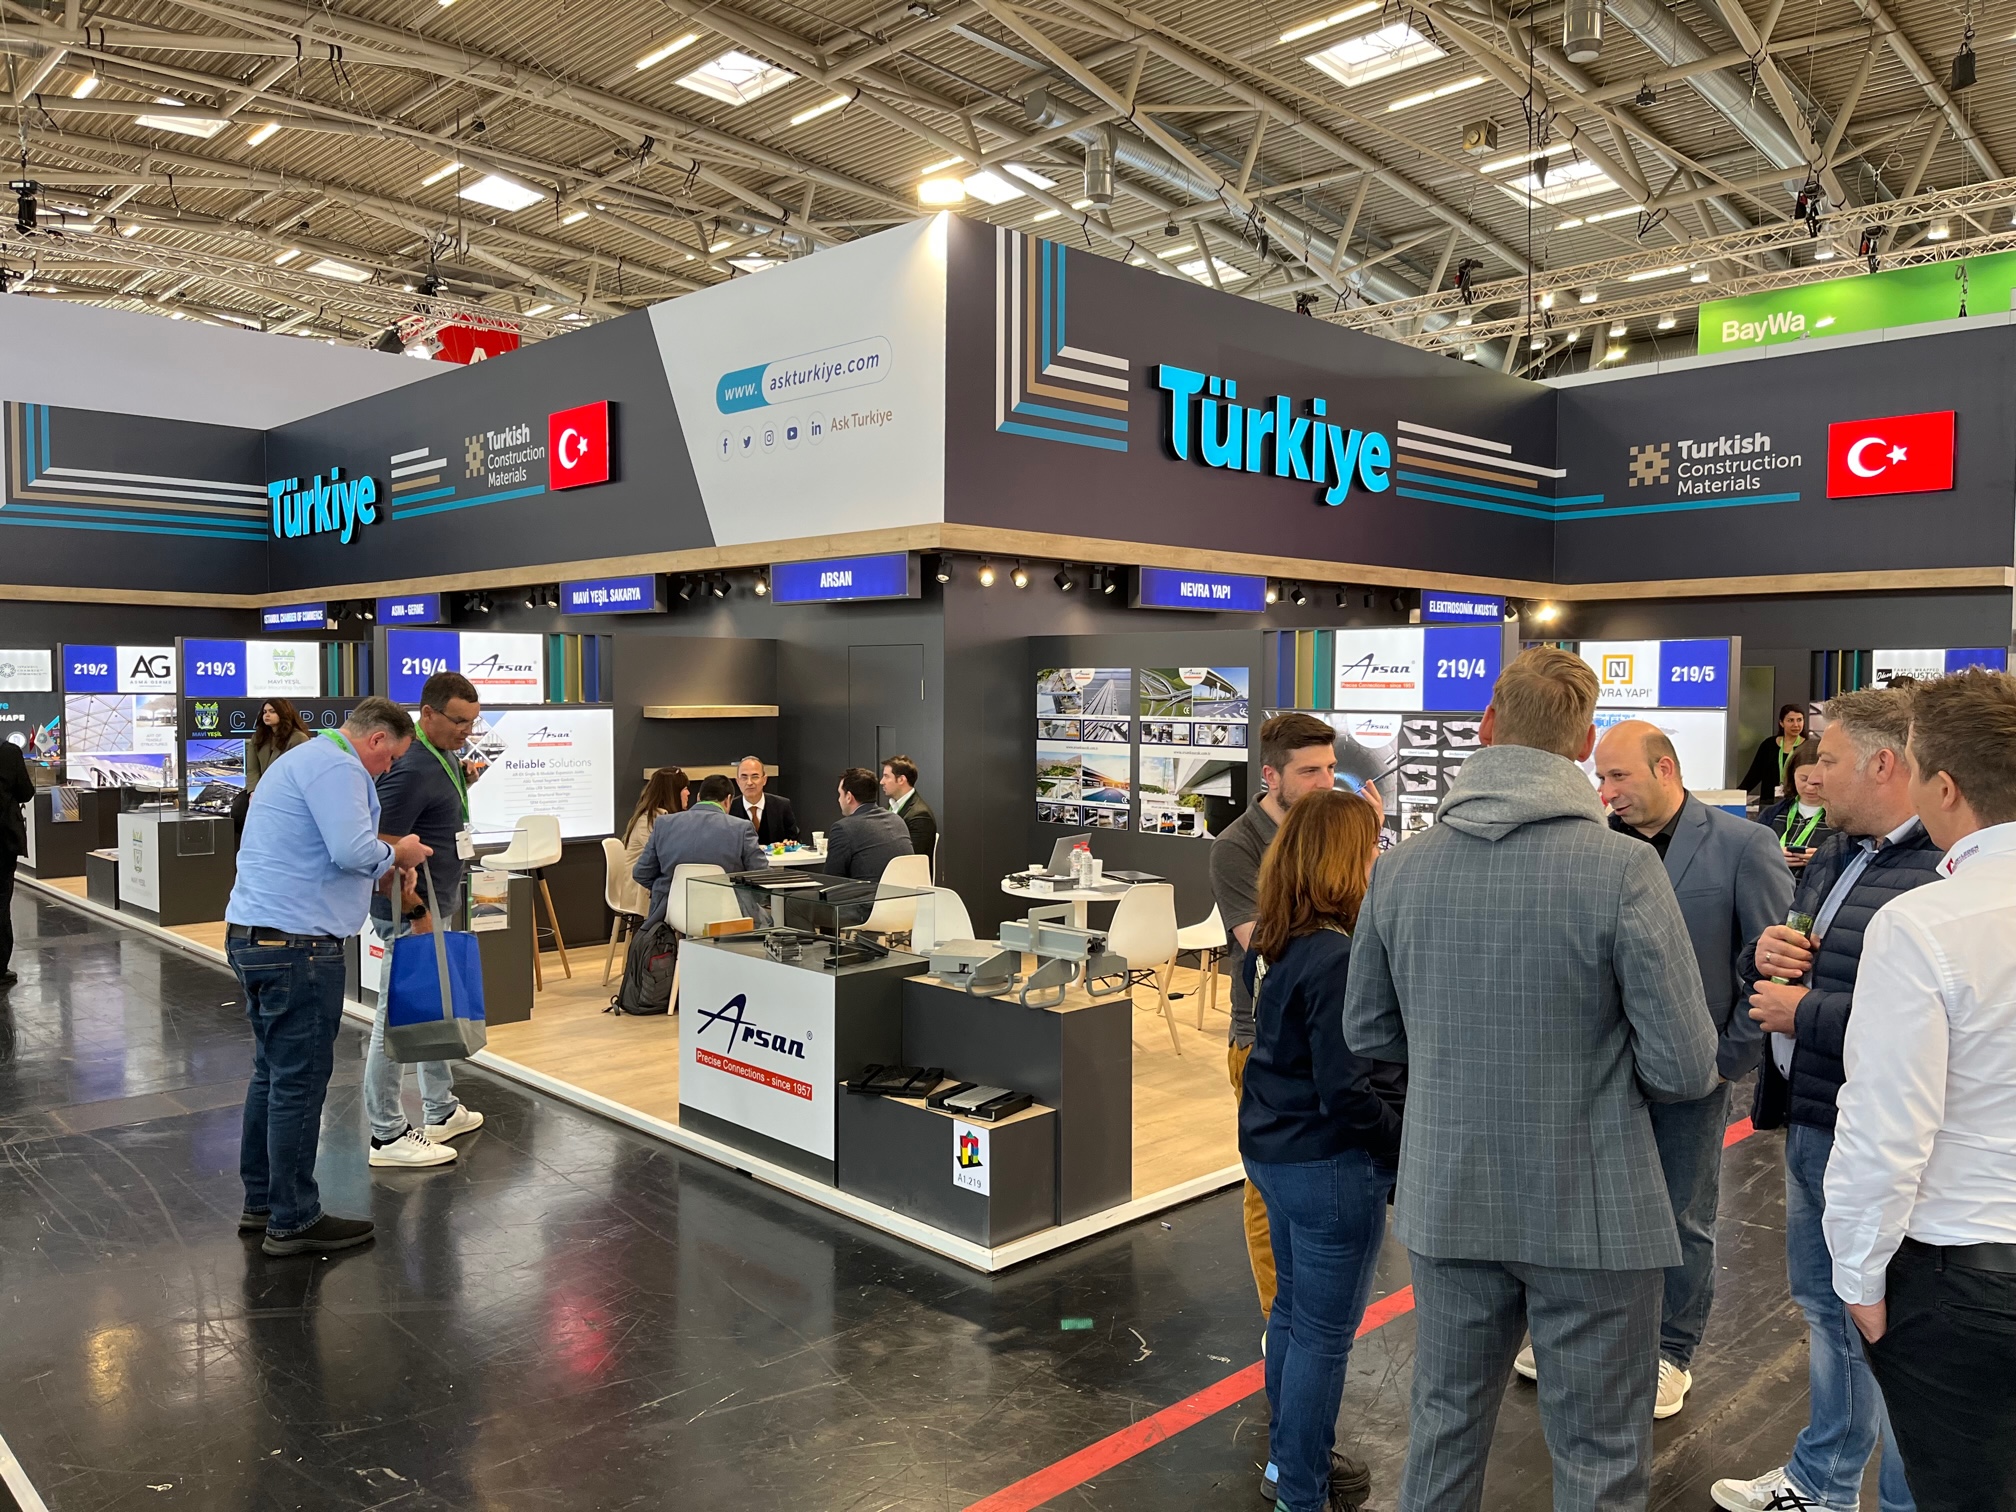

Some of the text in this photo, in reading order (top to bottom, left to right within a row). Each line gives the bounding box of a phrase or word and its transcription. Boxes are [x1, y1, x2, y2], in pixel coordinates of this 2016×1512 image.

[1722, 311, 1806, 343] BayWa
[725, 353, 880, 401] www. askturkiye.com
[830, 415, 850, 432] Ask
[851, 409, 893, 427] Turkiye
[487, 423, 530, 450] Turkish
[1159, 363, 1391, 506] Türkiye
[487, 444, 545, 469] Construction
[1677, 432, 1771, 460] Turkish
[1677, 452, 1802, 478] Construction
[487, 467, 527, 488] Materials
[1677, 474, 1761, 496] Materials
[267, 466, 377, 544] Türkiye
[820, 570, 853, 588] ARSAN
[573, 586, 641, 606] MAVİ YEŞİL SAKARYA
[1180, 582, 1231, 599] NEVRA YAPI
[1429, 600, 1498, 616] ELEKTROSONİK AKUSTİK
[74, 663, 108, 676] 219/2
[130, 655, 171, 678] AG
[196, 661, 236, 677] 219/3
[402, 657, 448, 677] 219/4
[468, 653, 533, 677] Arsan
[1341, 653, 1411, 681] Arsan
[1437, 658, 1486, 680] 219/4
[1671, 665, 1715, 683] 219/5
[1600, 688, 1650, 698] VRA YAPI
[528, 726, 570, 742] Arsan
[505, 758, 592, 770] Reliable Solutions
[697, 993, 806, 1059] Arsan
[697, 1051, 721, 1066] Precise
[722, 1059, 765, 1082] Connections
[771, 1076, 791, 1091] since
[792, 1082, 811, 1097] 1957
[958, 1173, 982, 1189] A1.219
